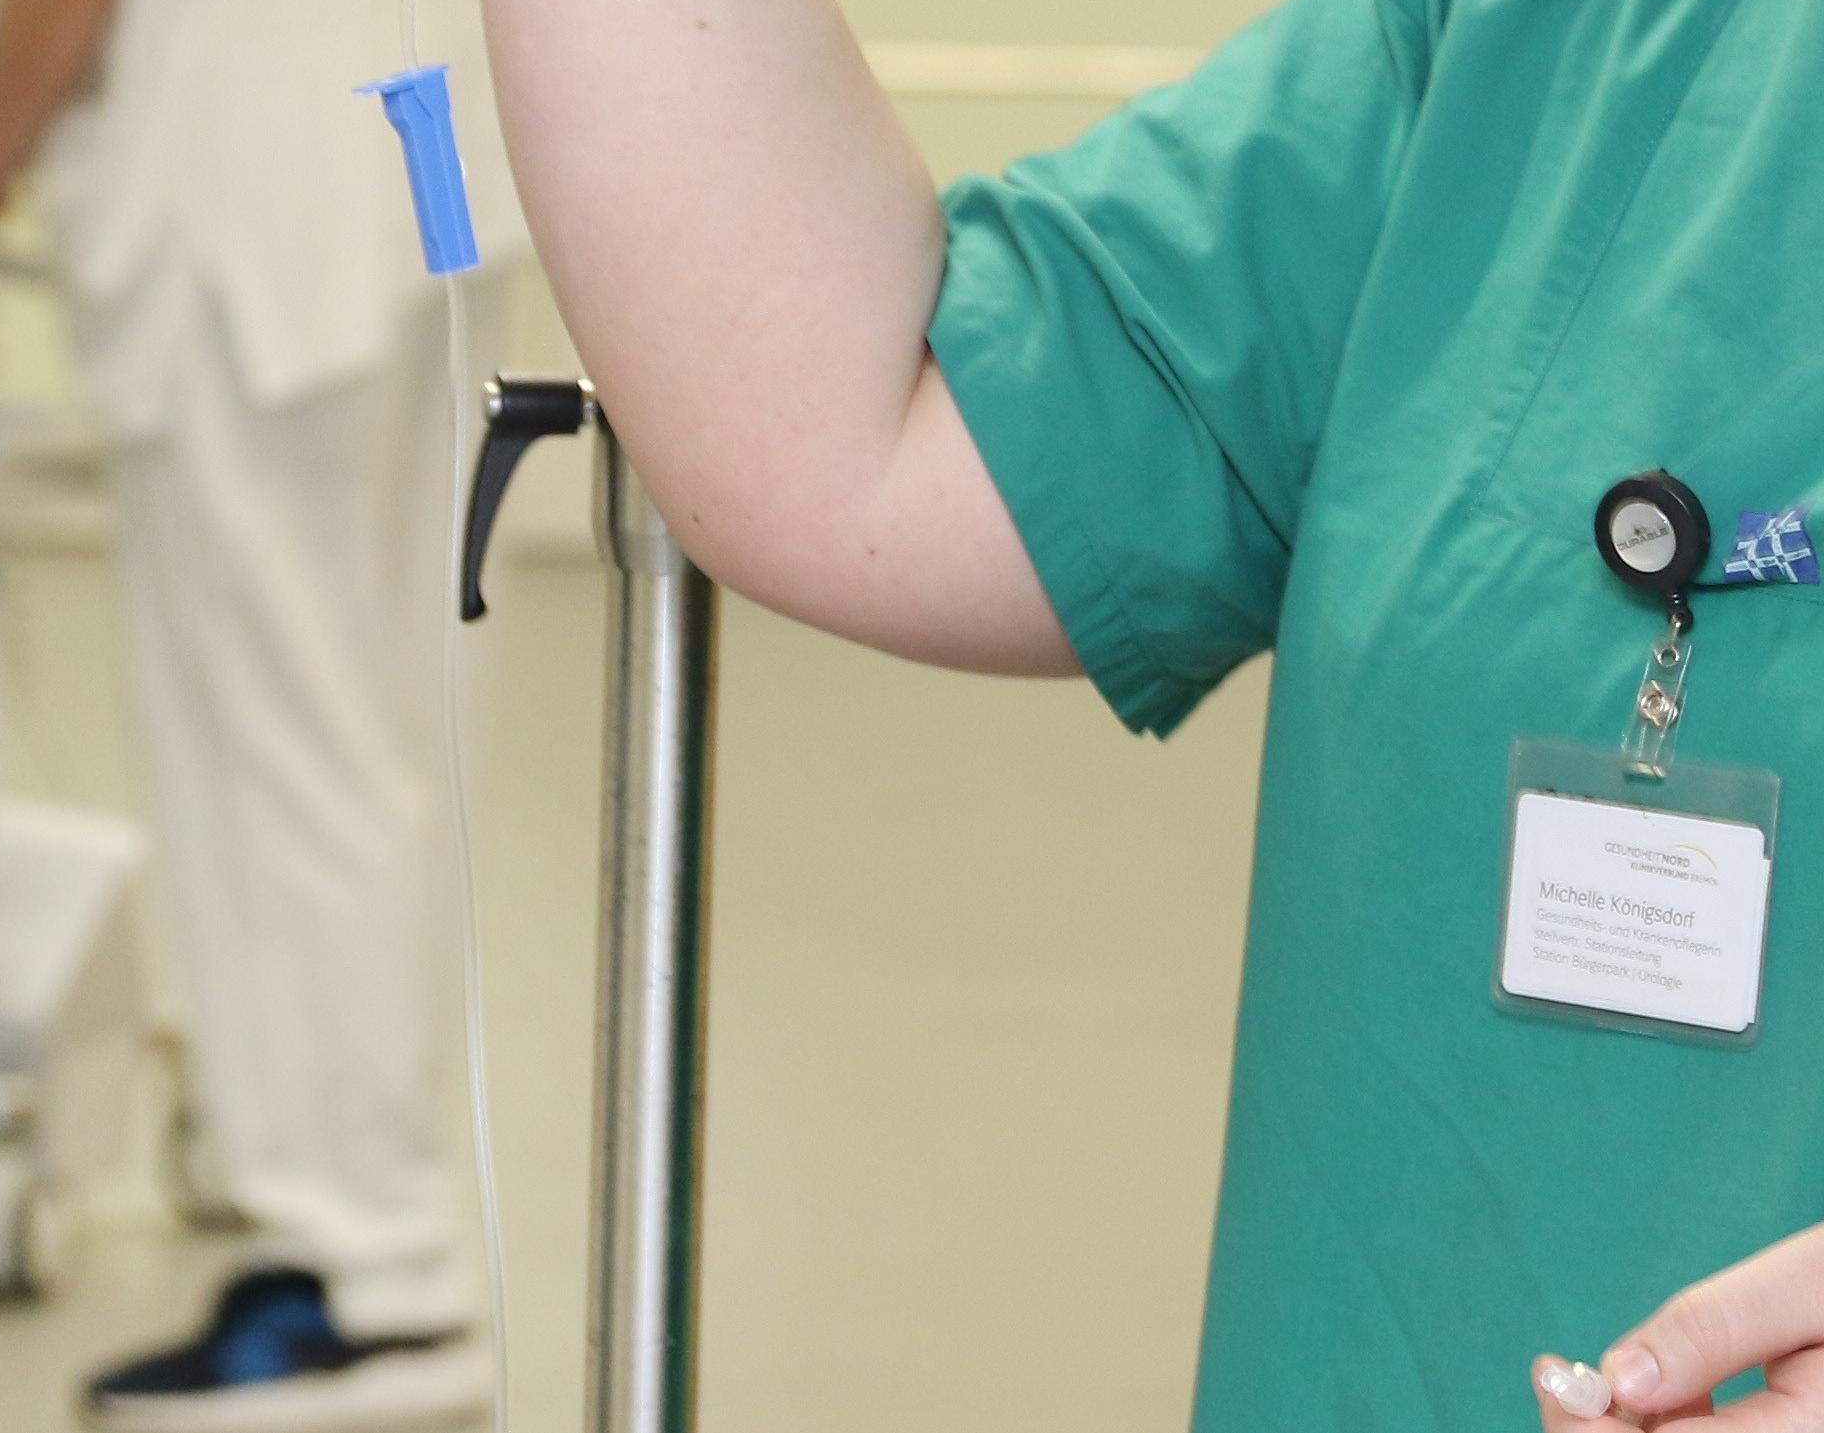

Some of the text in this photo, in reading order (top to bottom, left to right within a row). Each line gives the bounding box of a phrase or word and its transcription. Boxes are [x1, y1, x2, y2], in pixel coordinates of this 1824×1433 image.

[1536, 907, 1605, 932] Gesundheits-
[1609, 925, 1630, 938] und
[1538, 881, 1696, 929] Michelle Königsdorf
[1533, 946, 1569, 964] Station
[1571, 954, 1629, 976] Bürgerpark
[1638, 968, 1684, 989] Urologie
[1584, 937, 1663, 967] Stationsleitung
